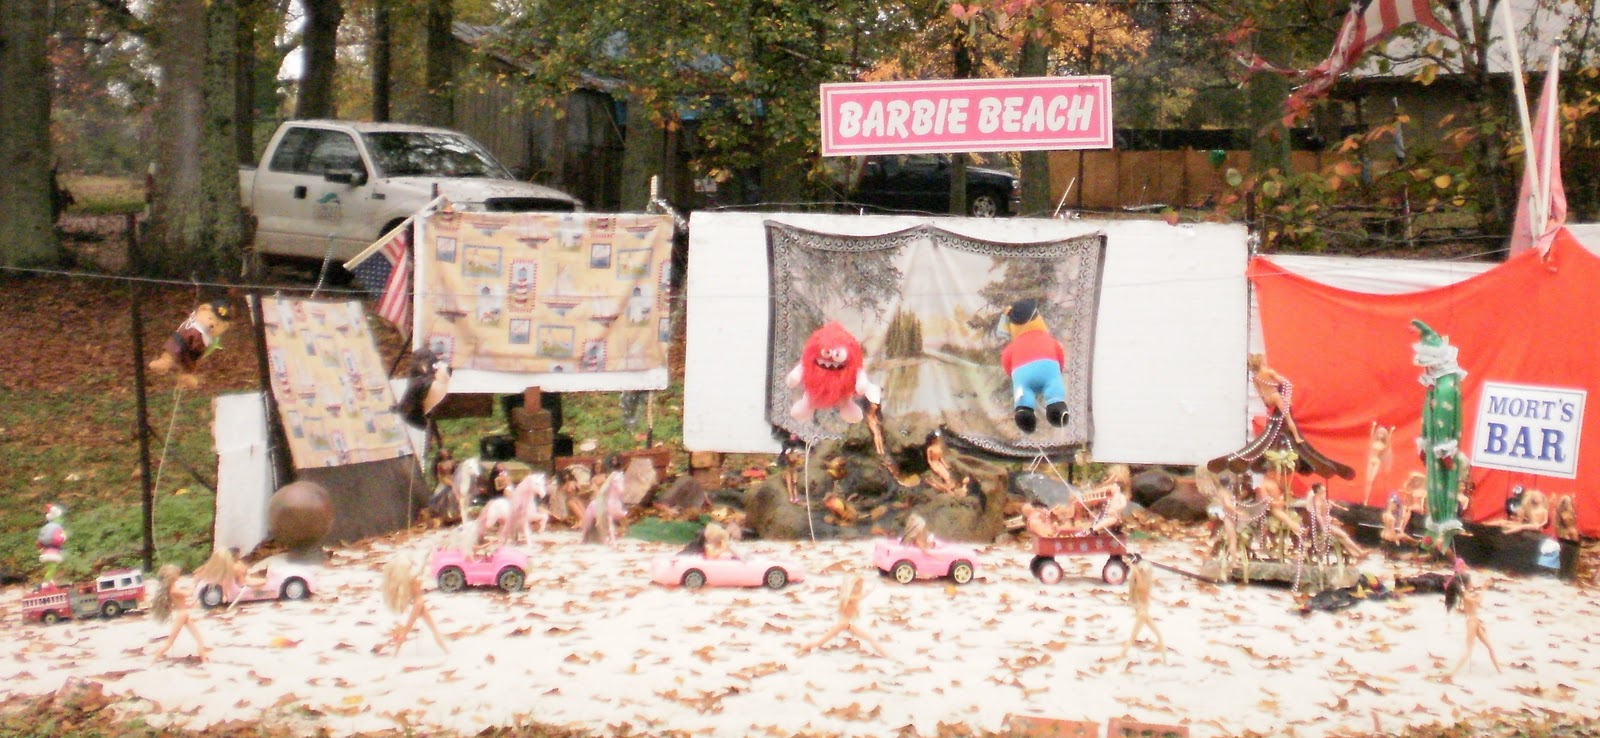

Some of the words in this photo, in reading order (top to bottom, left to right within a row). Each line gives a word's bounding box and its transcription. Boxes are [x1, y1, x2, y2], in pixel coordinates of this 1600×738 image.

[839, 98, 969, 139] BARBIE
[978, 94, 1094, 134] BEACH
[1487, 395, 1575, 422] MORT'S
[1484, 422, 1566, 463] BAR
